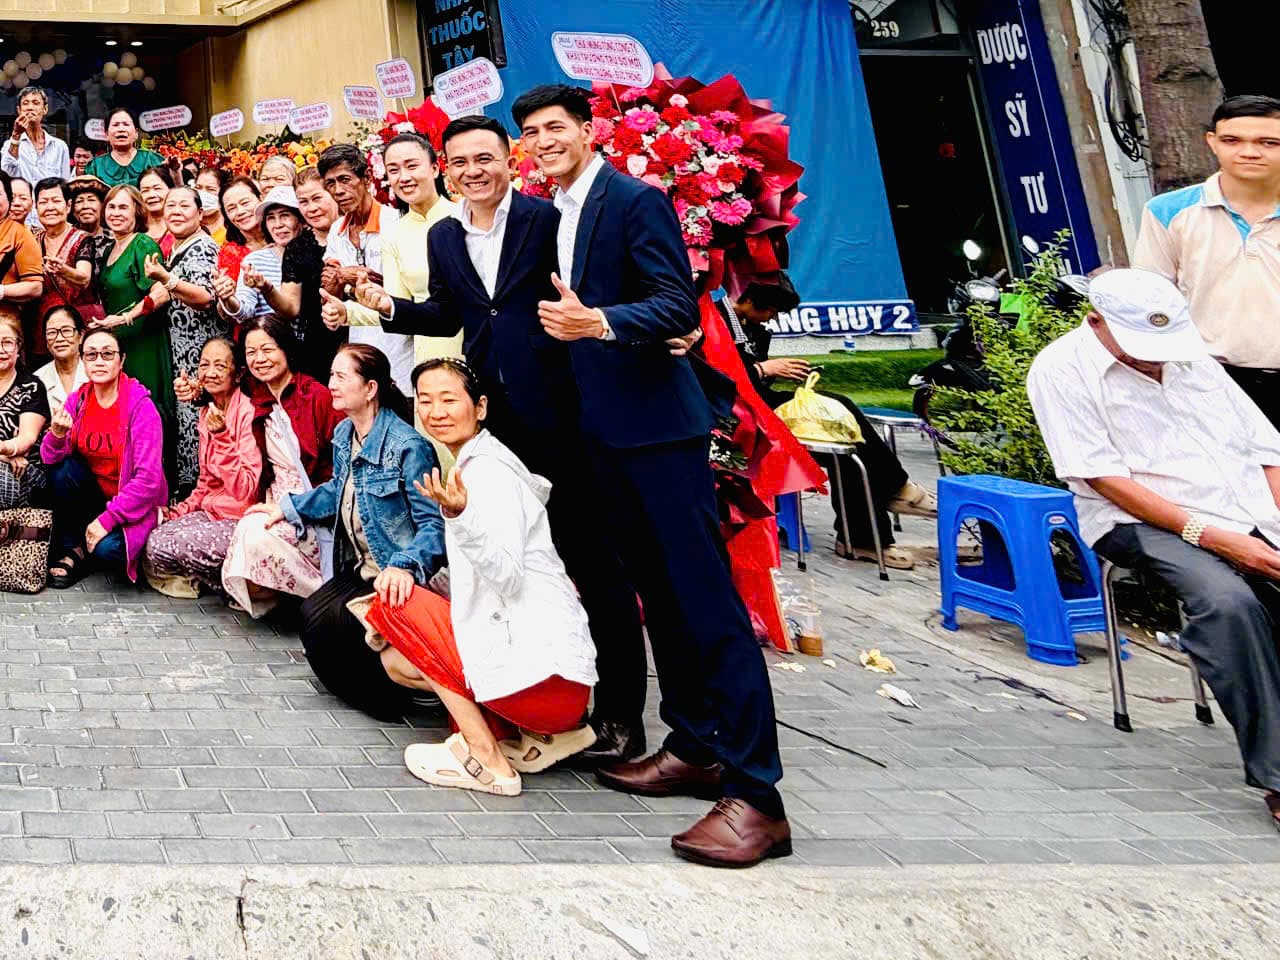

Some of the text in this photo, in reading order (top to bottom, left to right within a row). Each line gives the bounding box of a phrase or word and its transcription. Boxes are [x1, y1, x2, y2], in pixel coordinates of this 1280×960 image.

[428, 6, 486, 45] THUỐC
[870, 19, 900, 38] 259
[976, 21, 1027, 69] DƯỢC
[1004, 92, 1031, 138] SỸ
[1020, 171, 1049, 214] TƯ
[828, 306, 884, 332] HUY
[892, 305, 913, 329] 2
